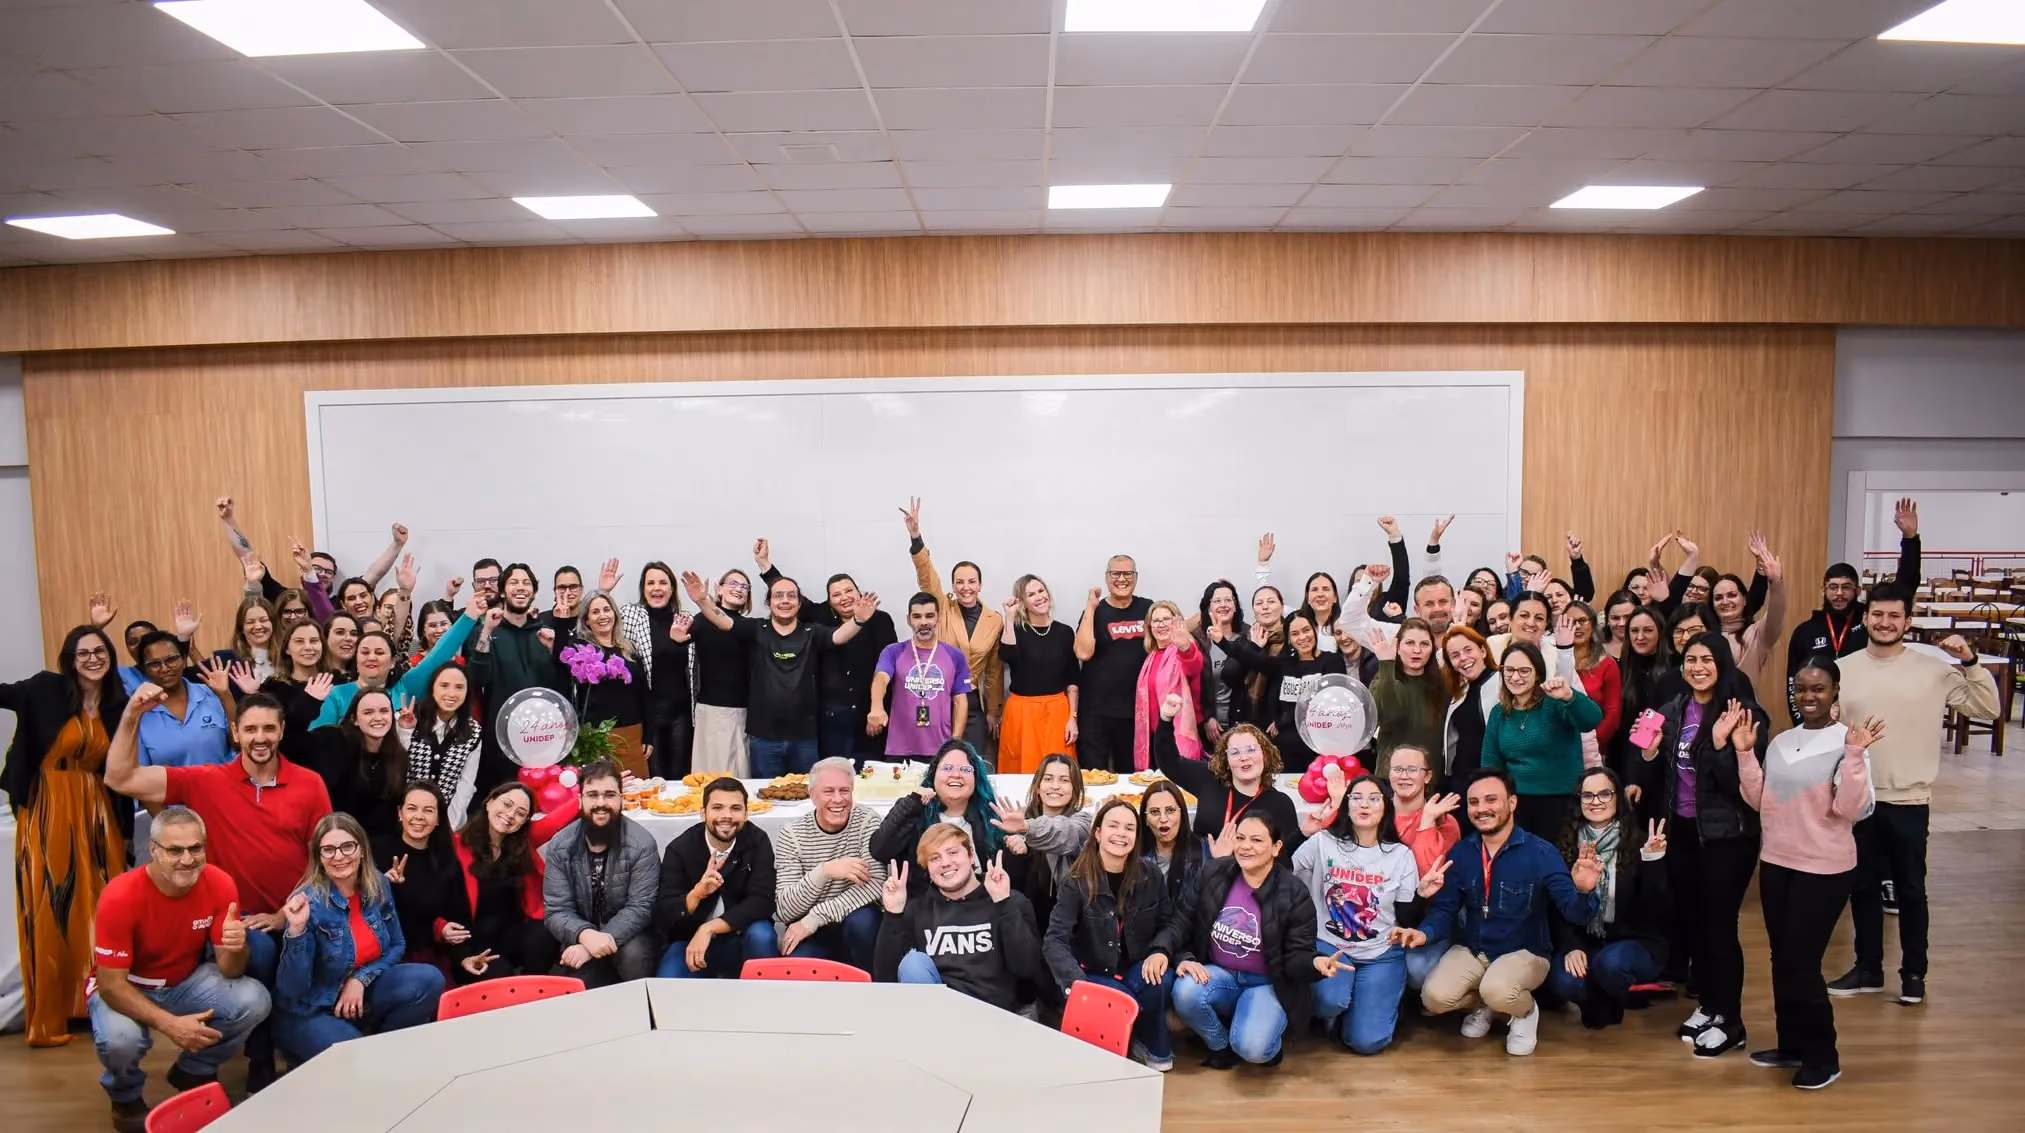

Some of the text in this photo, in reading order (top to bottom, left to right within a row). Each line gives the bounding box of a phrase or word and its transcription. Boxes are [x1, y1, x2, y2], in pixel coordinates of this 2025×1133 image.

[523, 734, 555, 743] UNIDEP
[1330, 867, 1384, 885] UNIDEP
[924, 923, 993, 956] VANS
[1211, 930, 1242, 946] NIDEP
[1213, 920, 1261, 946] NIVERSO
